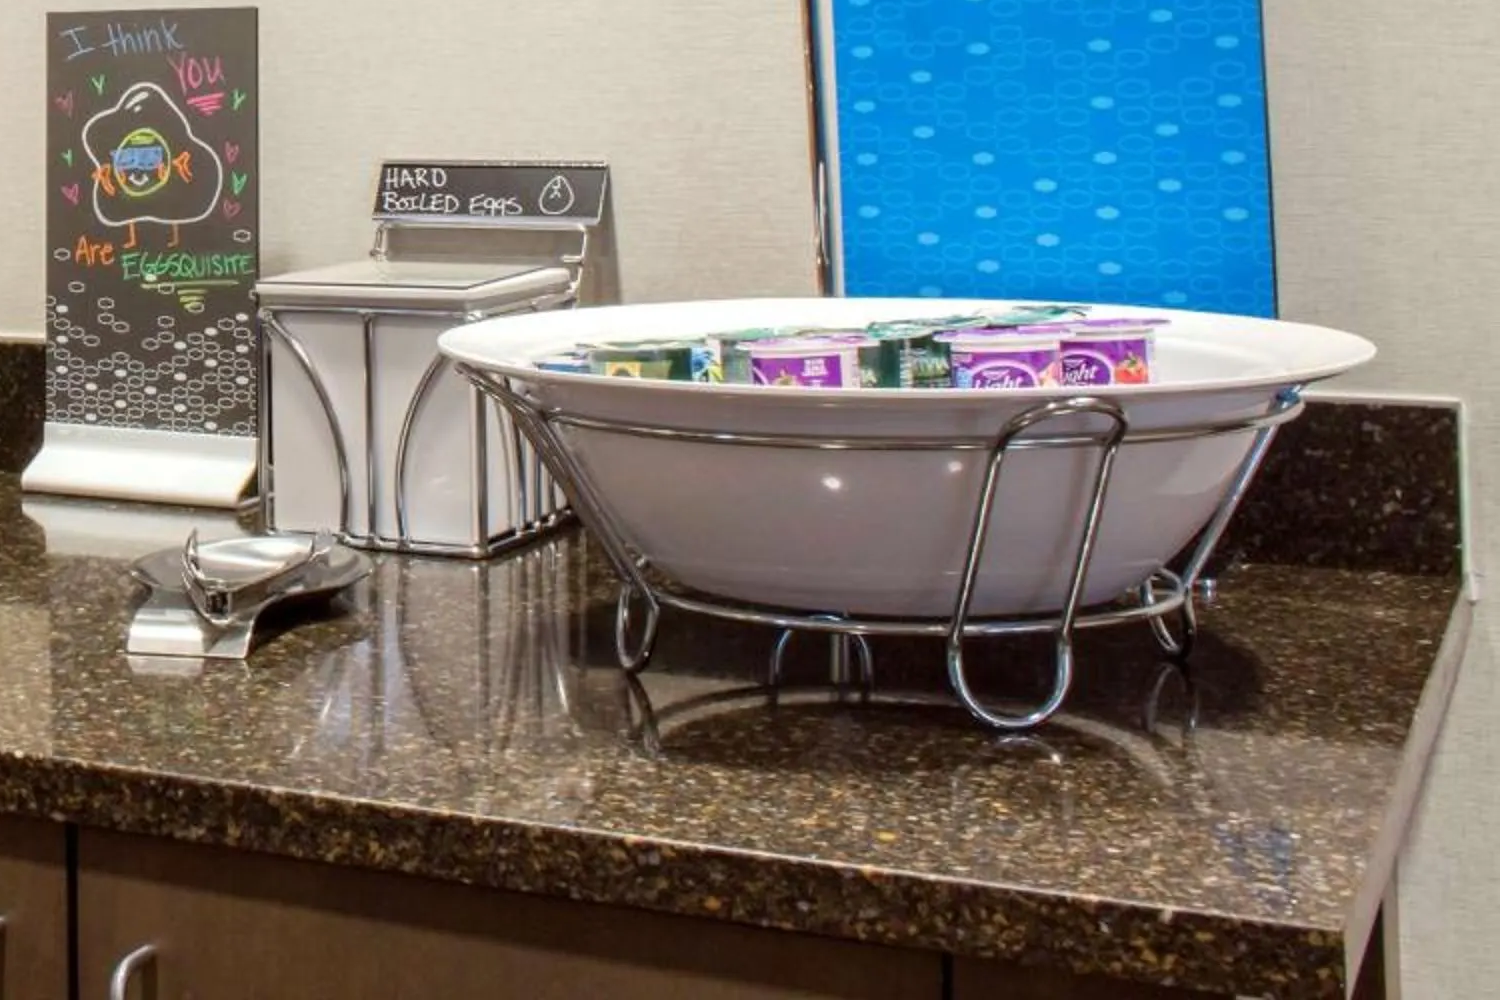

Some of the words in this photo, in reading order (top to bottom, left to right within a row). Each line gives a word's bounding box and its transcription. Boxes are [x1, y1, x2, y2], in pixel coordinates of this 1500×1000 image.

[101, 19, 185, 57] think
[385, 168, 447, 189] HARD
[75, 235, 115, 267] Are
